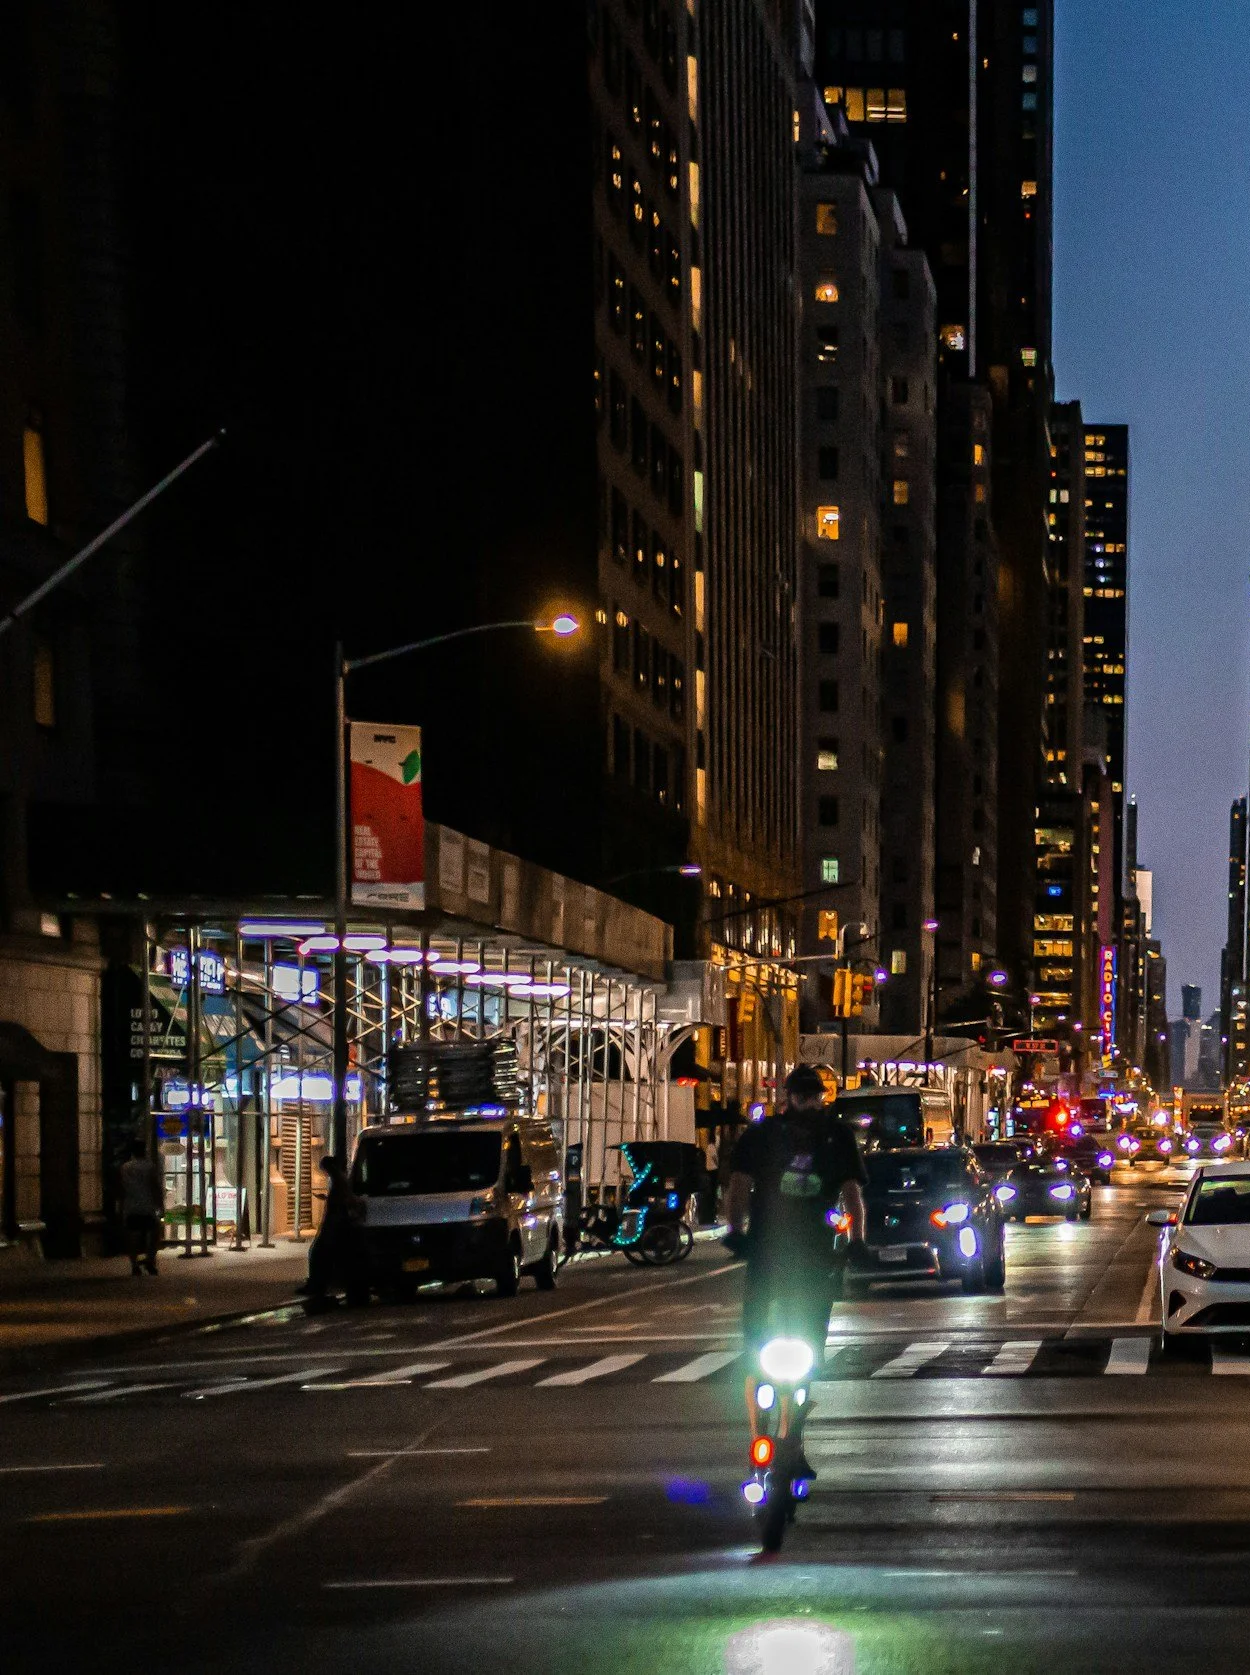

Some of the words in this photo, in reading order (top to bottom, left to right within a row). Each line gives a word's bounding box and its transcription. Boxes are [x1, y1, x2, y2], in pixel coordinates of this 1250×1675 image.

[1103, 950, 1113, 1003] RADIO
[130, 1008, 159, 1019] LOO
[130, 1022, 163, 1032] CADY
[130, 1035, 186, 1046] CIARETTES
